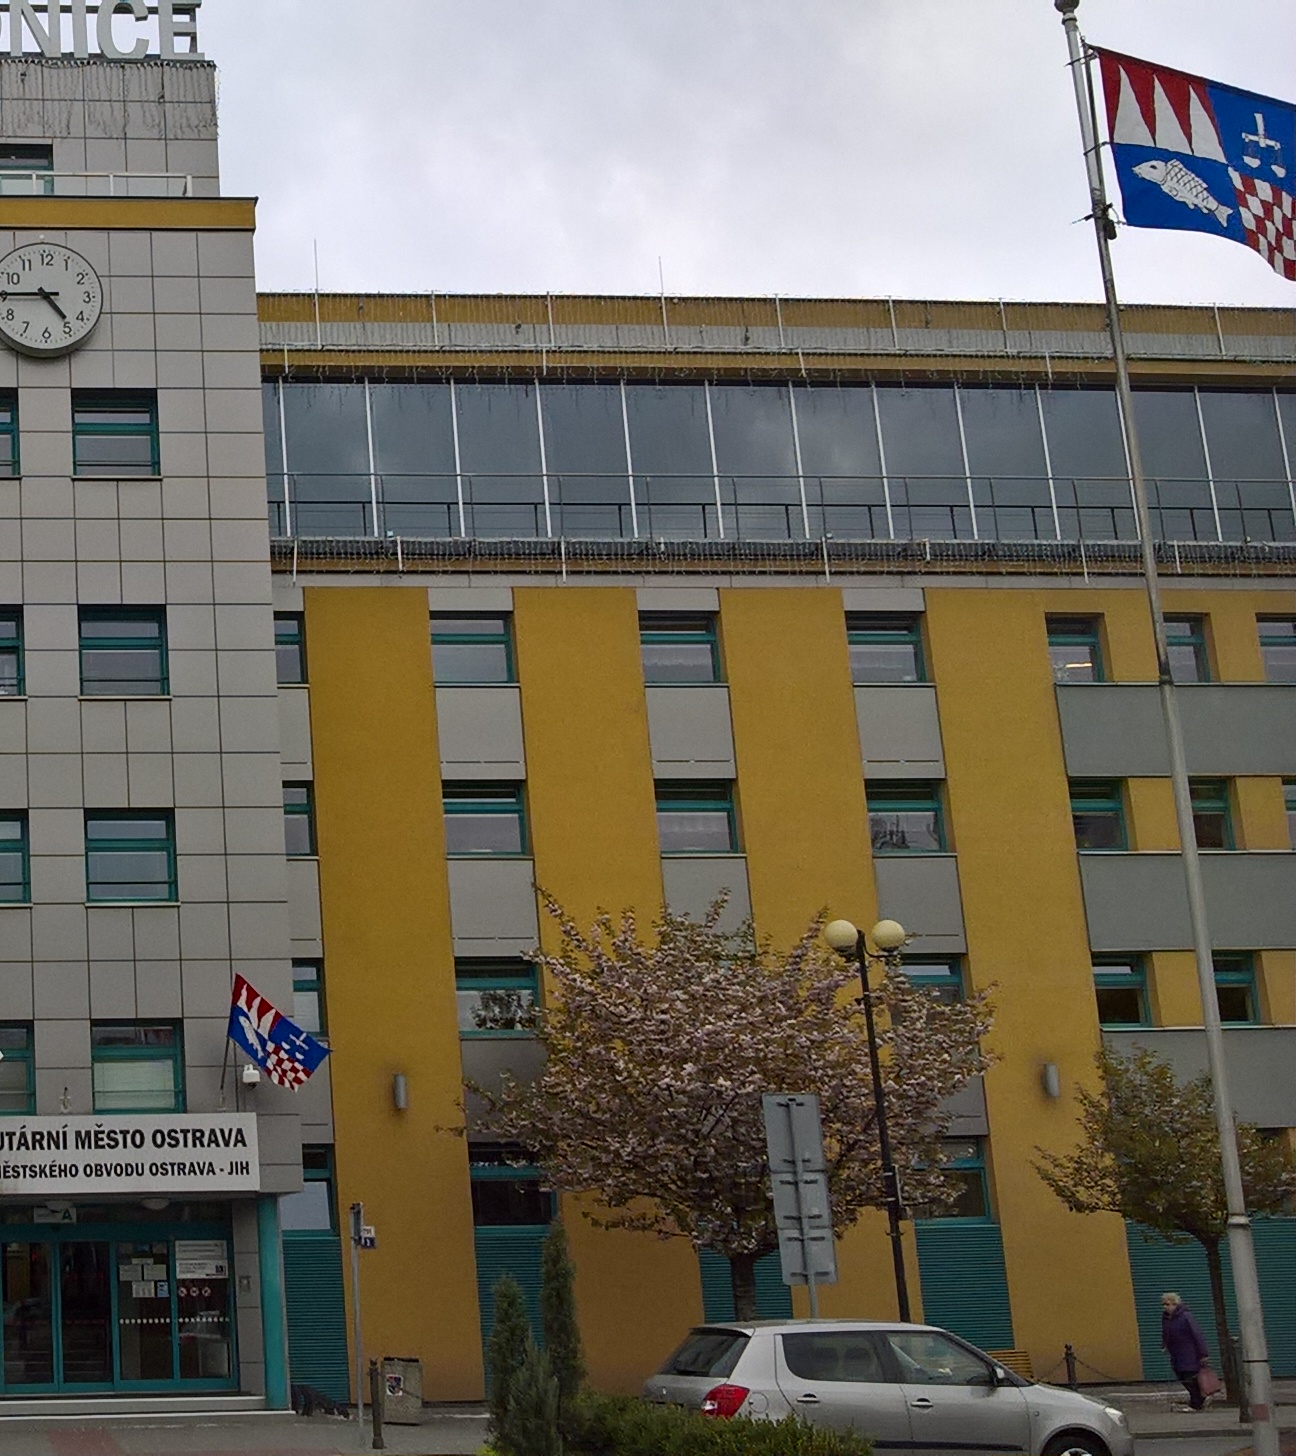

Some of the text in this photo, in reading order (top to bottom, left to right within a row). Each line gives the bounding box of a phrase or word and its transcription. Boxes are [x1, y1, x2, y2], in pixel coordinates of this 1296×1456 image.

[21, 259, 32, 271] 11
[40, 253, 54, 266] 12
[64, 259, 69, 271] 1
[6, 272, 20, 285] 10
[76, 272, 85, 285] 2
[83, 291, 91, 304] 3
[6, 308, 15, 320] 8
[76, 310, 84, 323] 4
[22, 321, 30, 334] 7
[42, 327, 52, 340] 6
[63, 322, 72, 335] 5
[75, 1123, 145, 1150] MĚSTO
[152, 1128, 247, 1149] OSTRAVA
[83, 1163, 145, 1178] OBVODU
[149, 1161, 216, 1176] OSTRAVA
[228, 1161, 250, 1175] JIH
